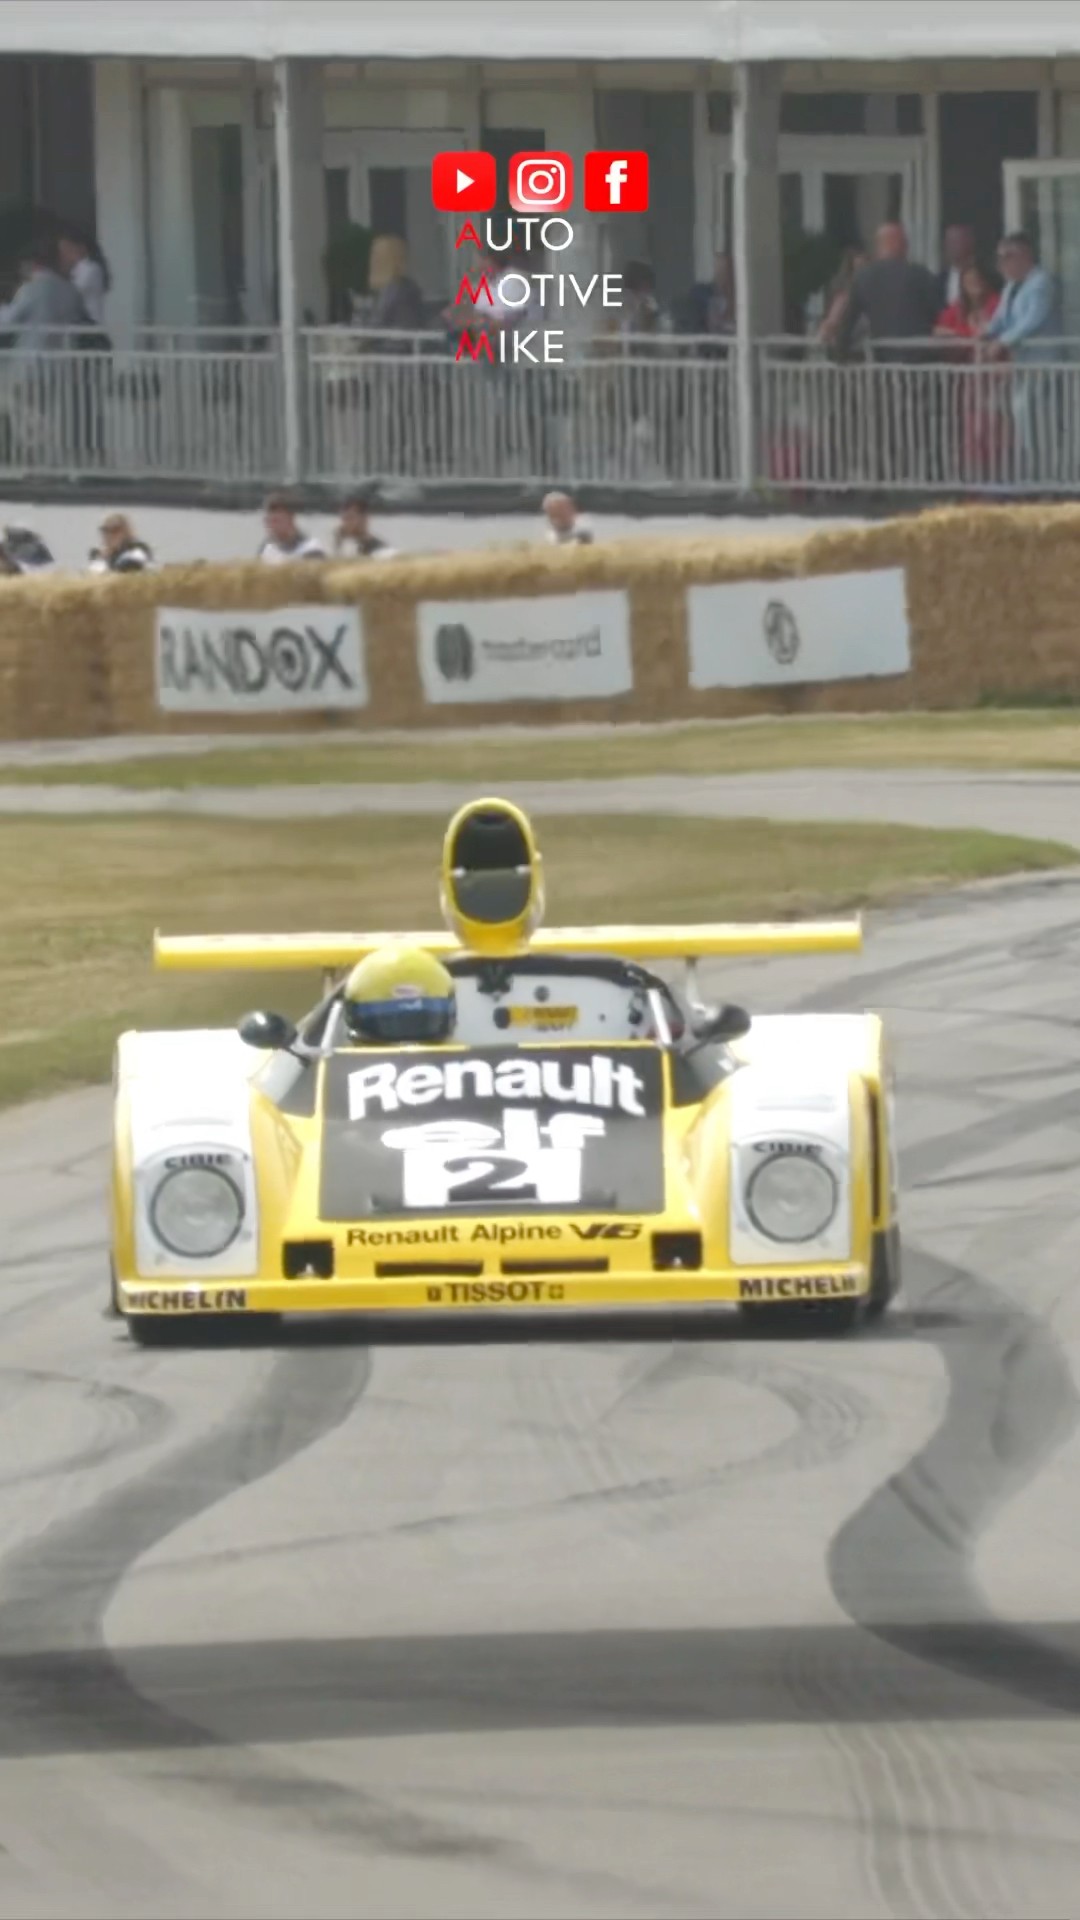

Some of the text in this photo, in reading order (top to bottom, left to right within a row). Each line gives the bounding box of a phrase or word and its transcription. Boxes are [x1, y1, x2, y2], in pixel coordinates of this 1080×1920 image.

[160, 623, 356, 695] RANDOX
[481, 624, 602, 663] tcard
[347, 1054, 646, 1121] Renault
[380, 1107, 606, 1152] elf
[442, 1155, 538, 1202] 2
[346, 1226, 460, 1247] Renault
[469, 1222, 562, 1244] Alpine
[445, 1280, 545, 1302] TISSOT
